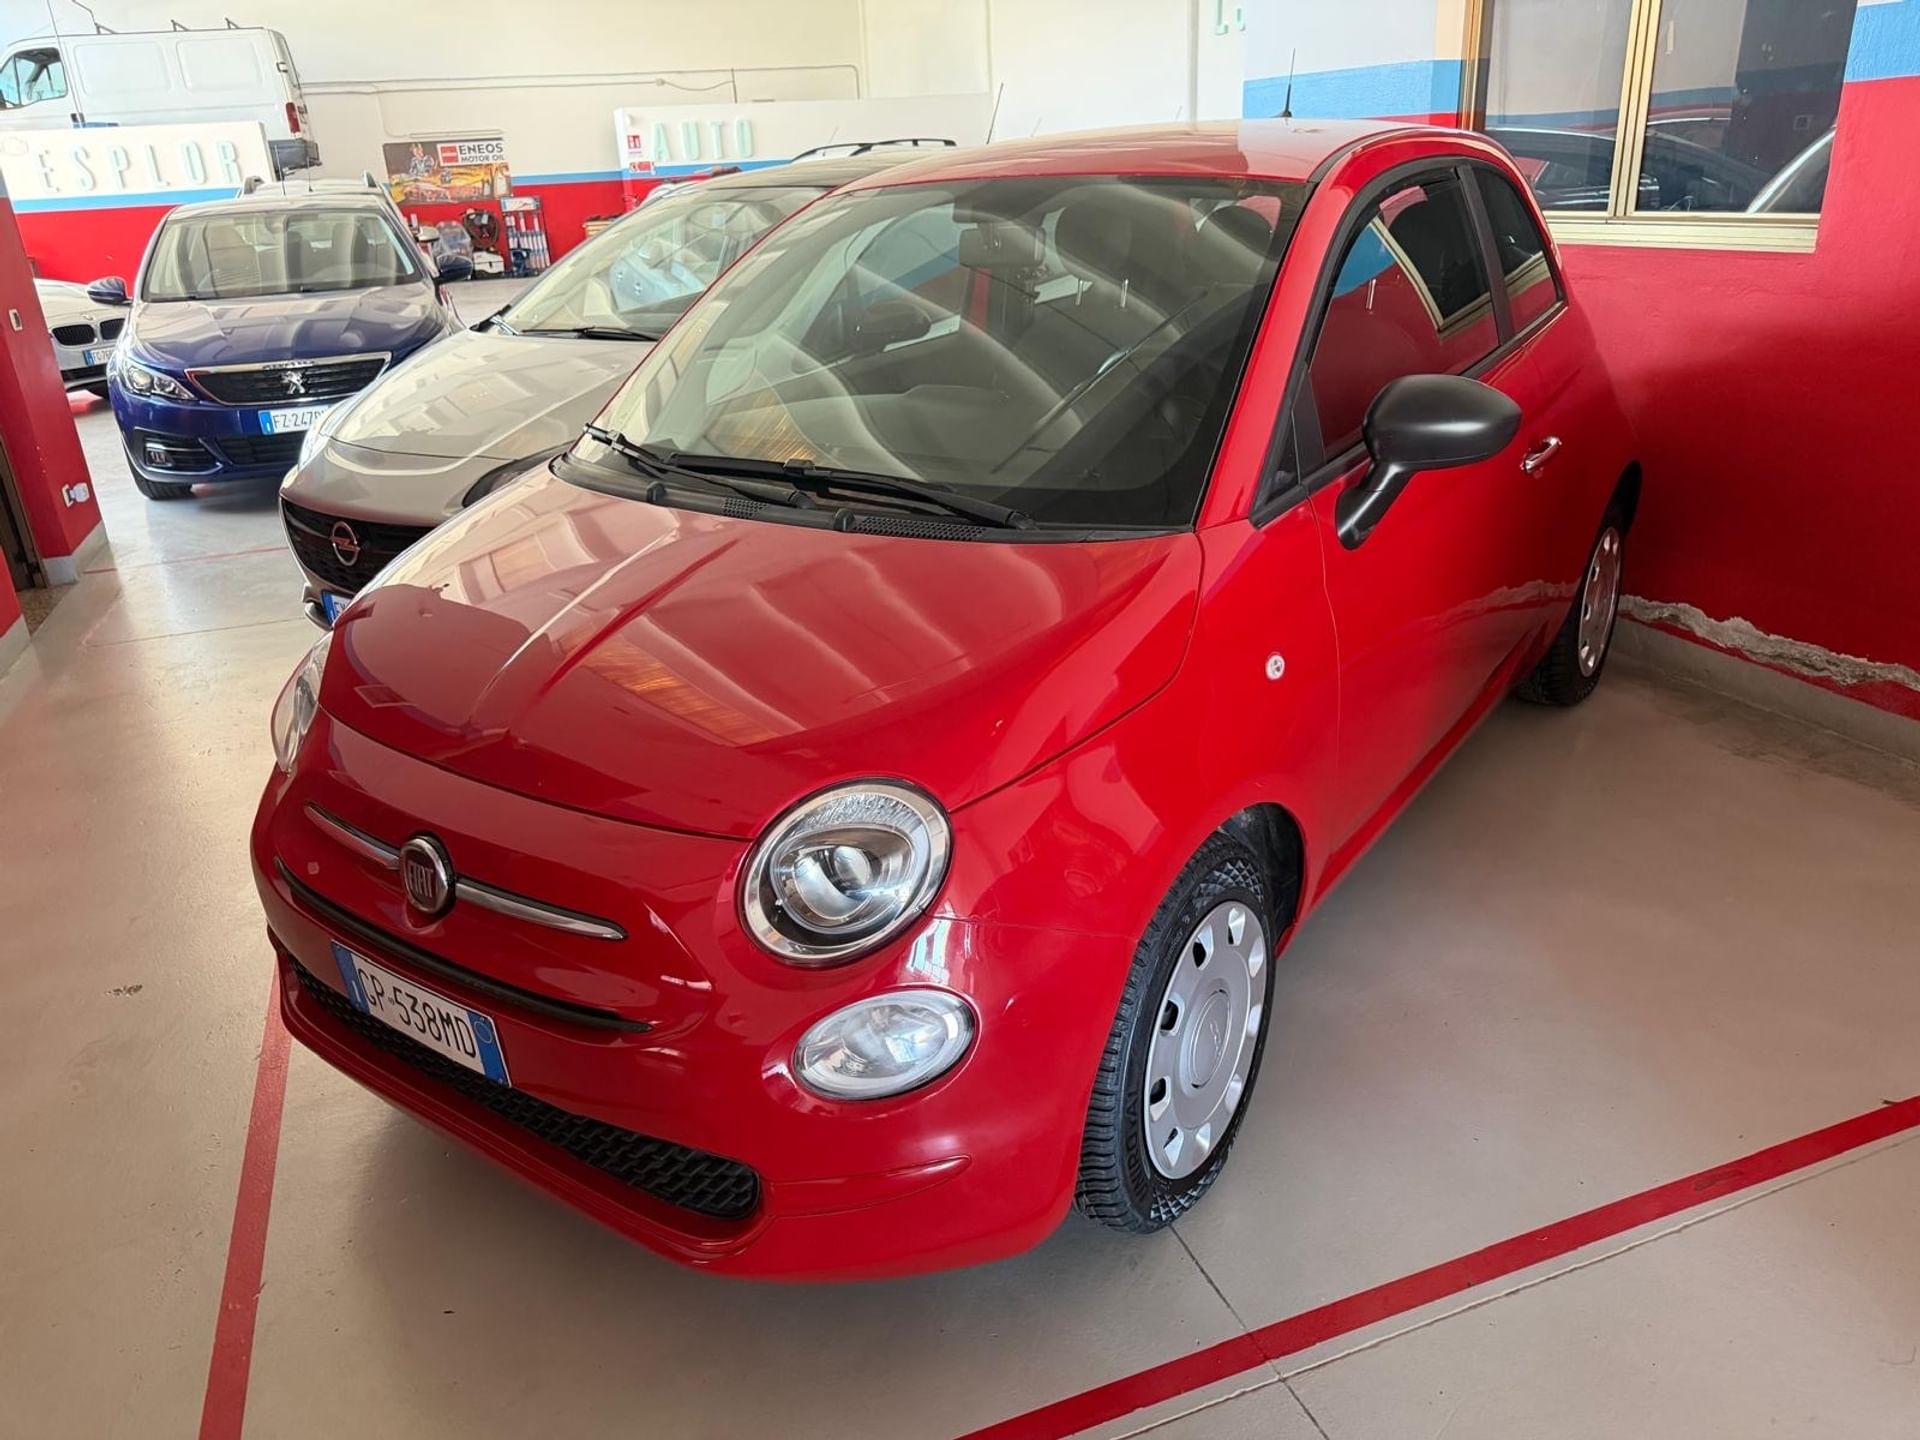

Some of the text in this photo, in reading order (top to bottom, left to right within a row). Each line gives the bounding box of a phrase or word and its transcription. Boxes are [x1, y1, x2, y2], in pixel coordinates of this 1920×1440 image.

[459, 143, 503, 155] ENEOS
[652, 118, 754, 161] AUTO
[36, 139, 243, 193] ESPLOR
[407, 861, 434, 898] FIAT
[393, 986, 476, 1058] 538MD
